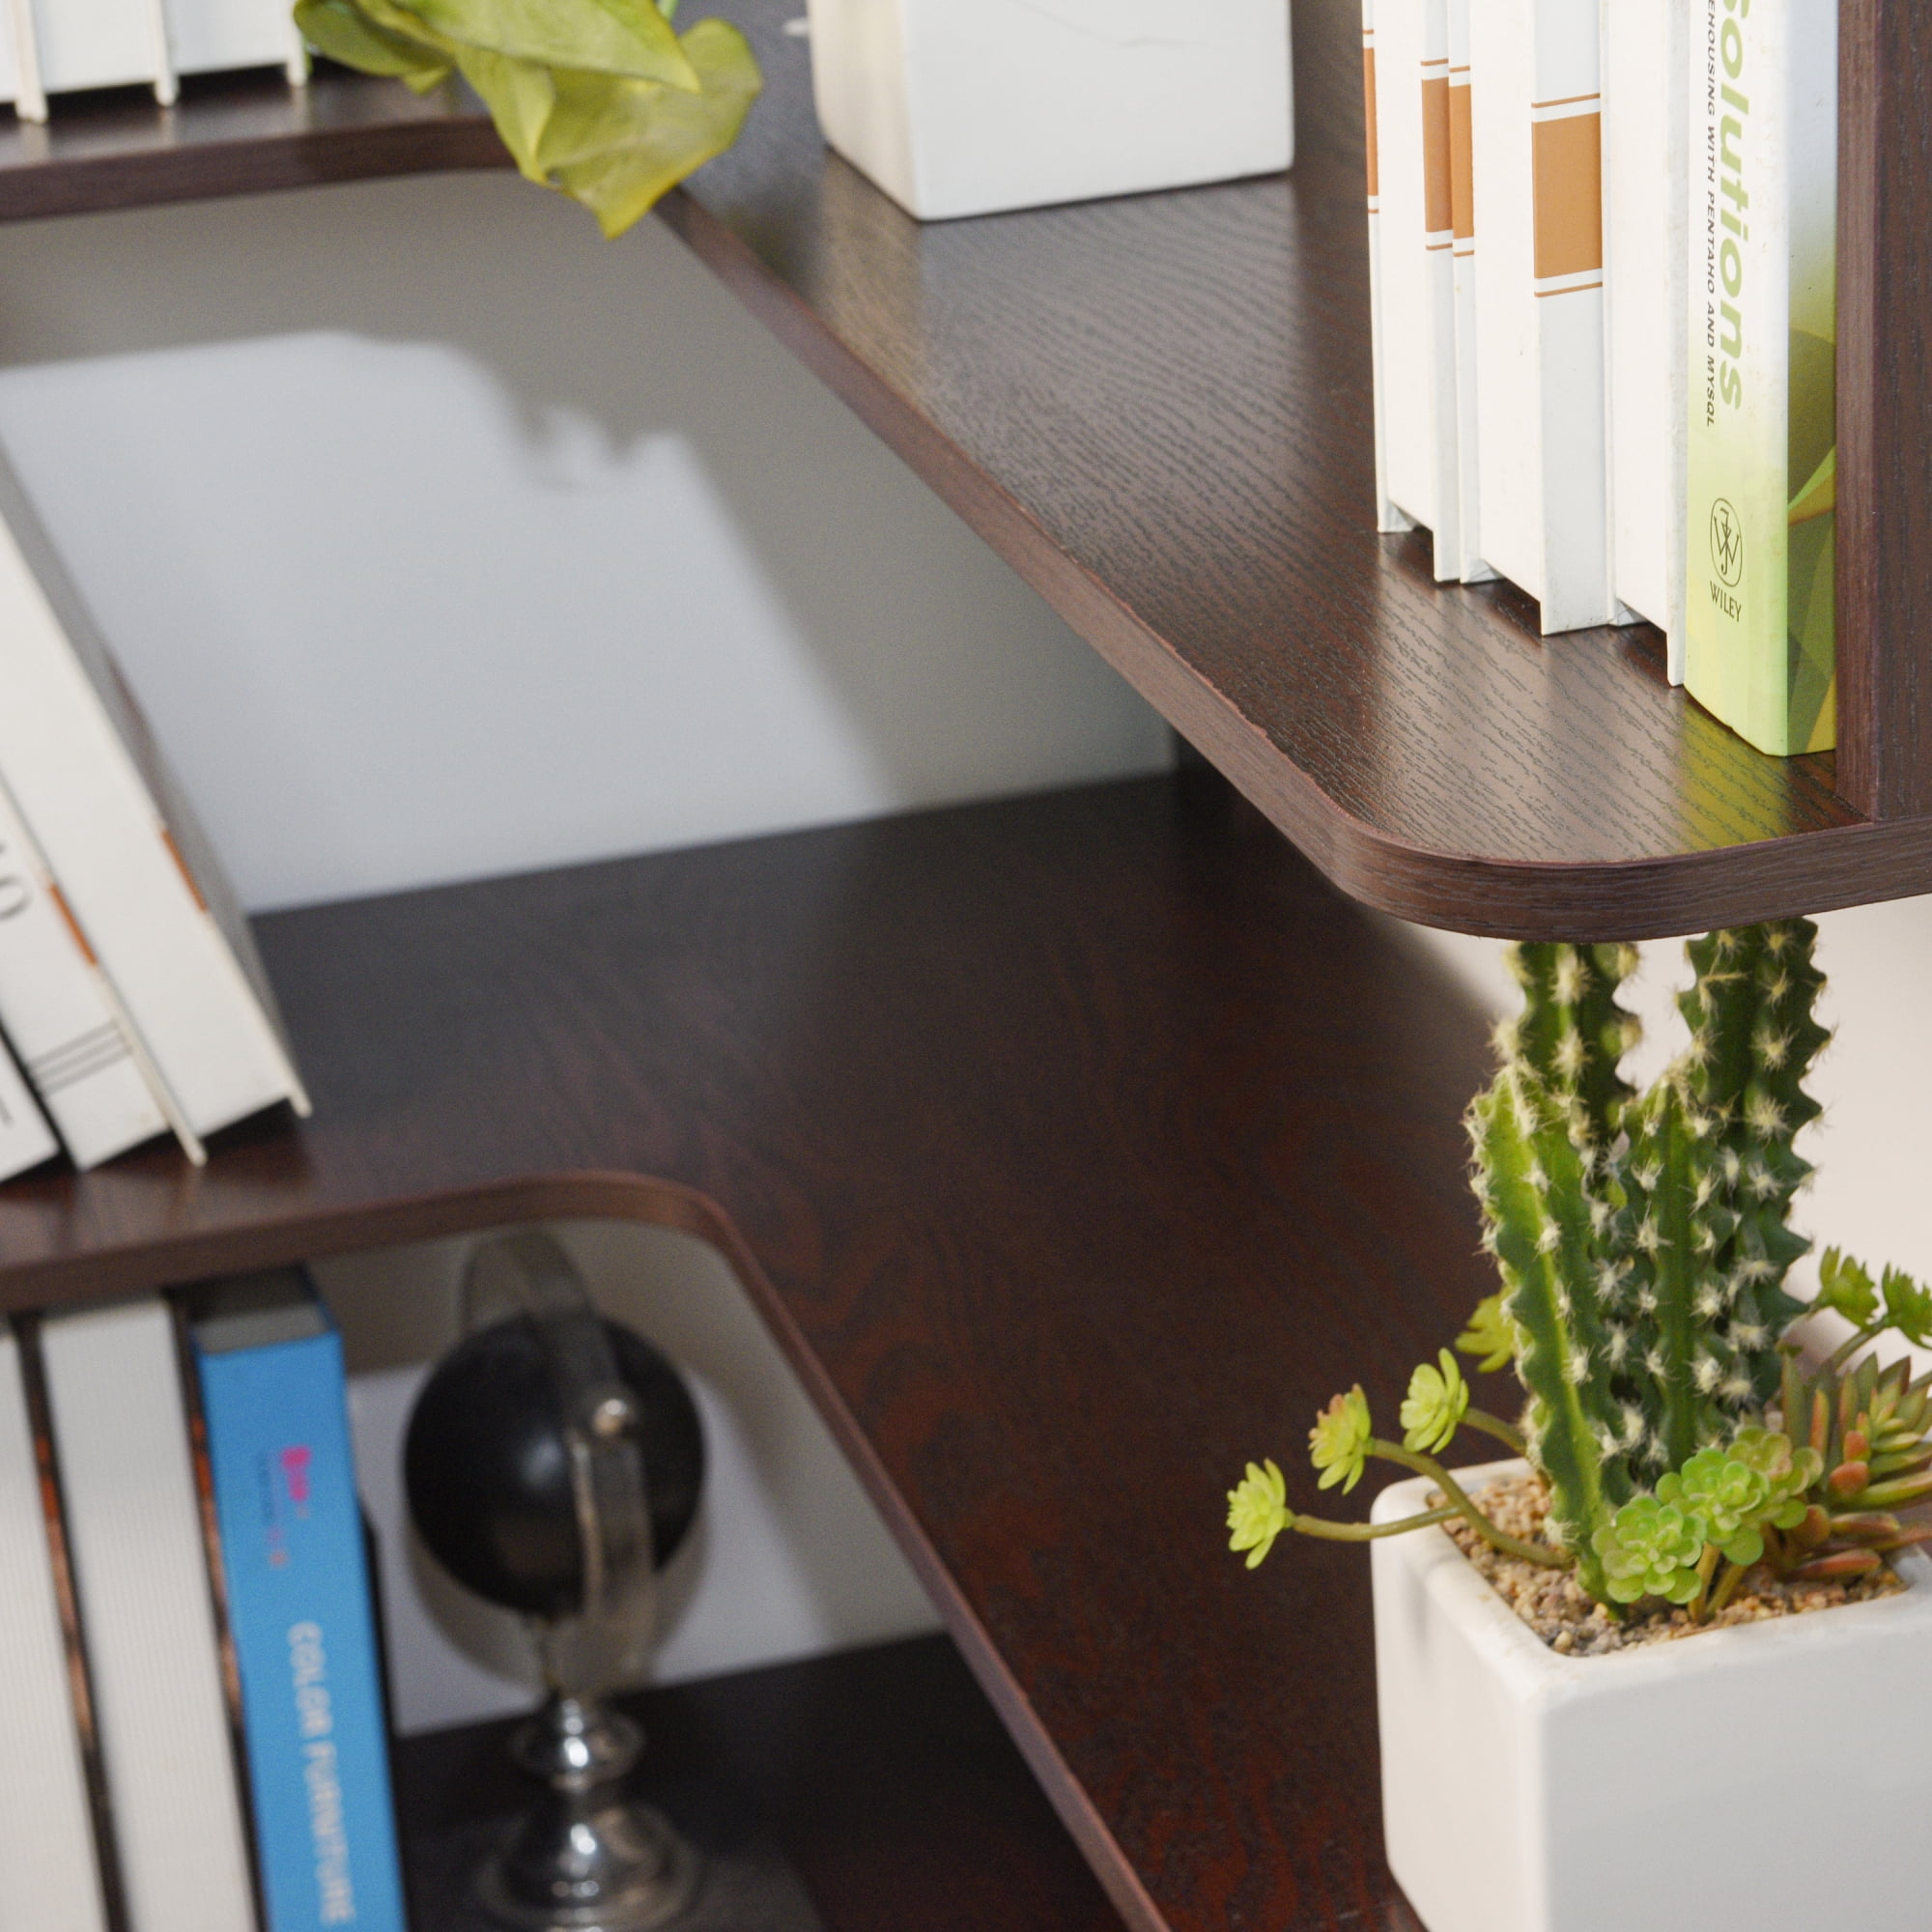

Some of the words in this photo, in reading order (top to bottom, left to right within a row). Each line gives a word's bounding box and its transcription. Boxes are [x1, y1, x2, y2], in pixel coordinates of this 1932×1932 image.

[1707, 126, 1716, 183] WITH
[1707, 190, 1716, 294] PENTAHO
[1706, 355, 1715, 427] MYSQL
[1709, 580, 1742, 623] WILEY
[287, 1621, 334, 1737] COLOR
